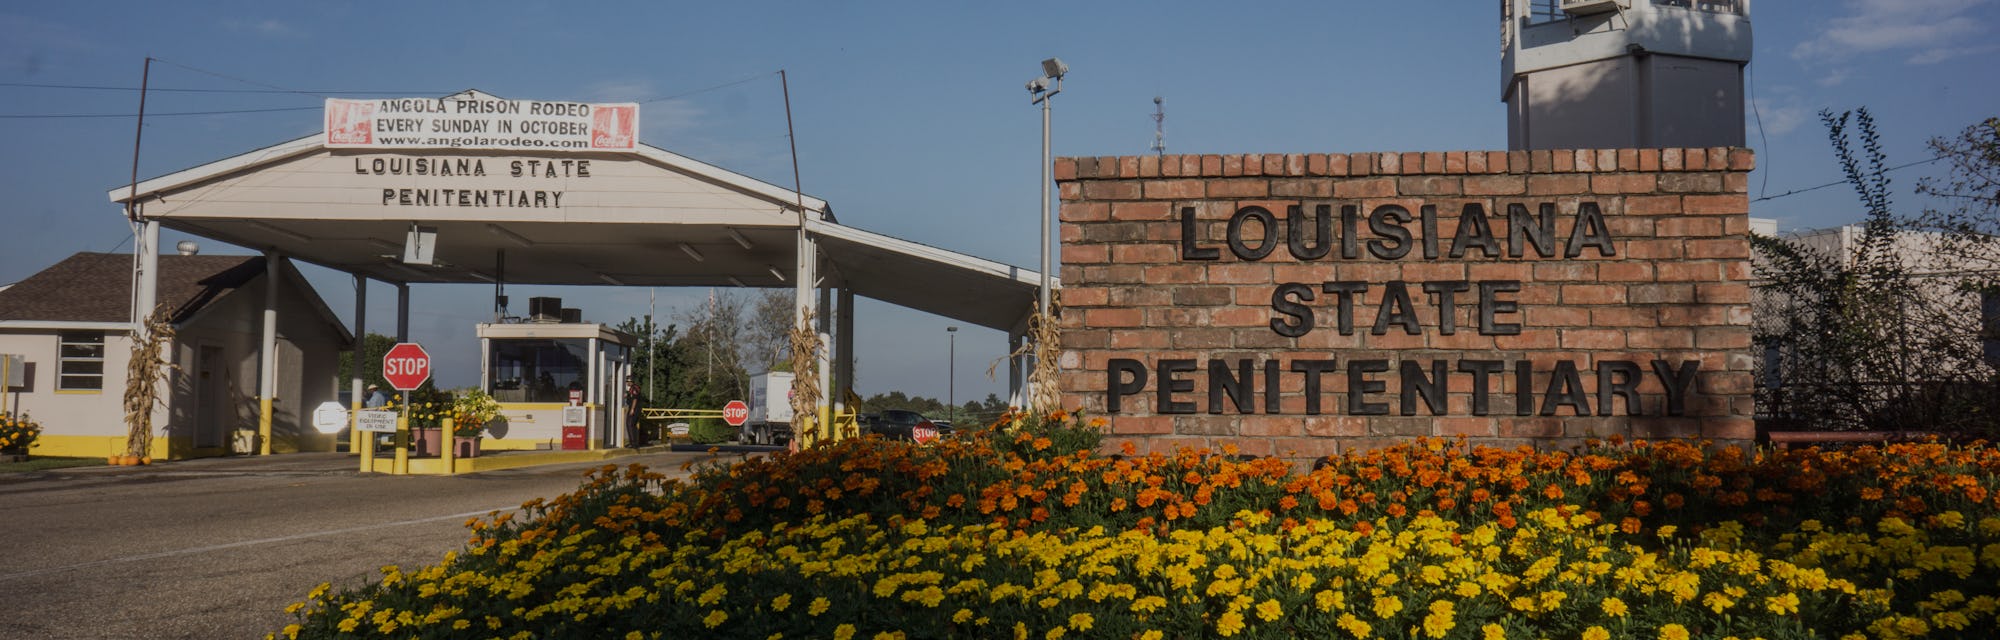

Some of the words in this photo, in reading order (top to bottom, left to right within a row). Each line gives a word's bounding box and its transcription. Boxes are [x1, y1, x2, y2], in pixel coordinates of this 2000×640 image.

[379, 100, 447, 114] ANGOLA
[456, 101, 520, 115] PRISON
[530, 102, 590, 117] RODEO
[377, 119, 424, 132] EVERY
[431, 120, 489, 134] SUNDAY
[498, 120, 512, 134] IN
[520, 120, 588, 136] OCTOBER
[379, 136, 588, 148] www.angolarodeo.com
[355, 158, 486, 176] LOUISIANA
[510, 160, 591, 178] STATE
[382, 189, 563, 208] PENITENTIARY
[1181, 202, 1616, 261] LOUISIANA
[1269, 280, 1522, 338] STATE
[387, 357, 427, 375] STOP
[1106, 359, 1701, 417] PENITENTIARY
[725, 408, 747, 417] STOP
